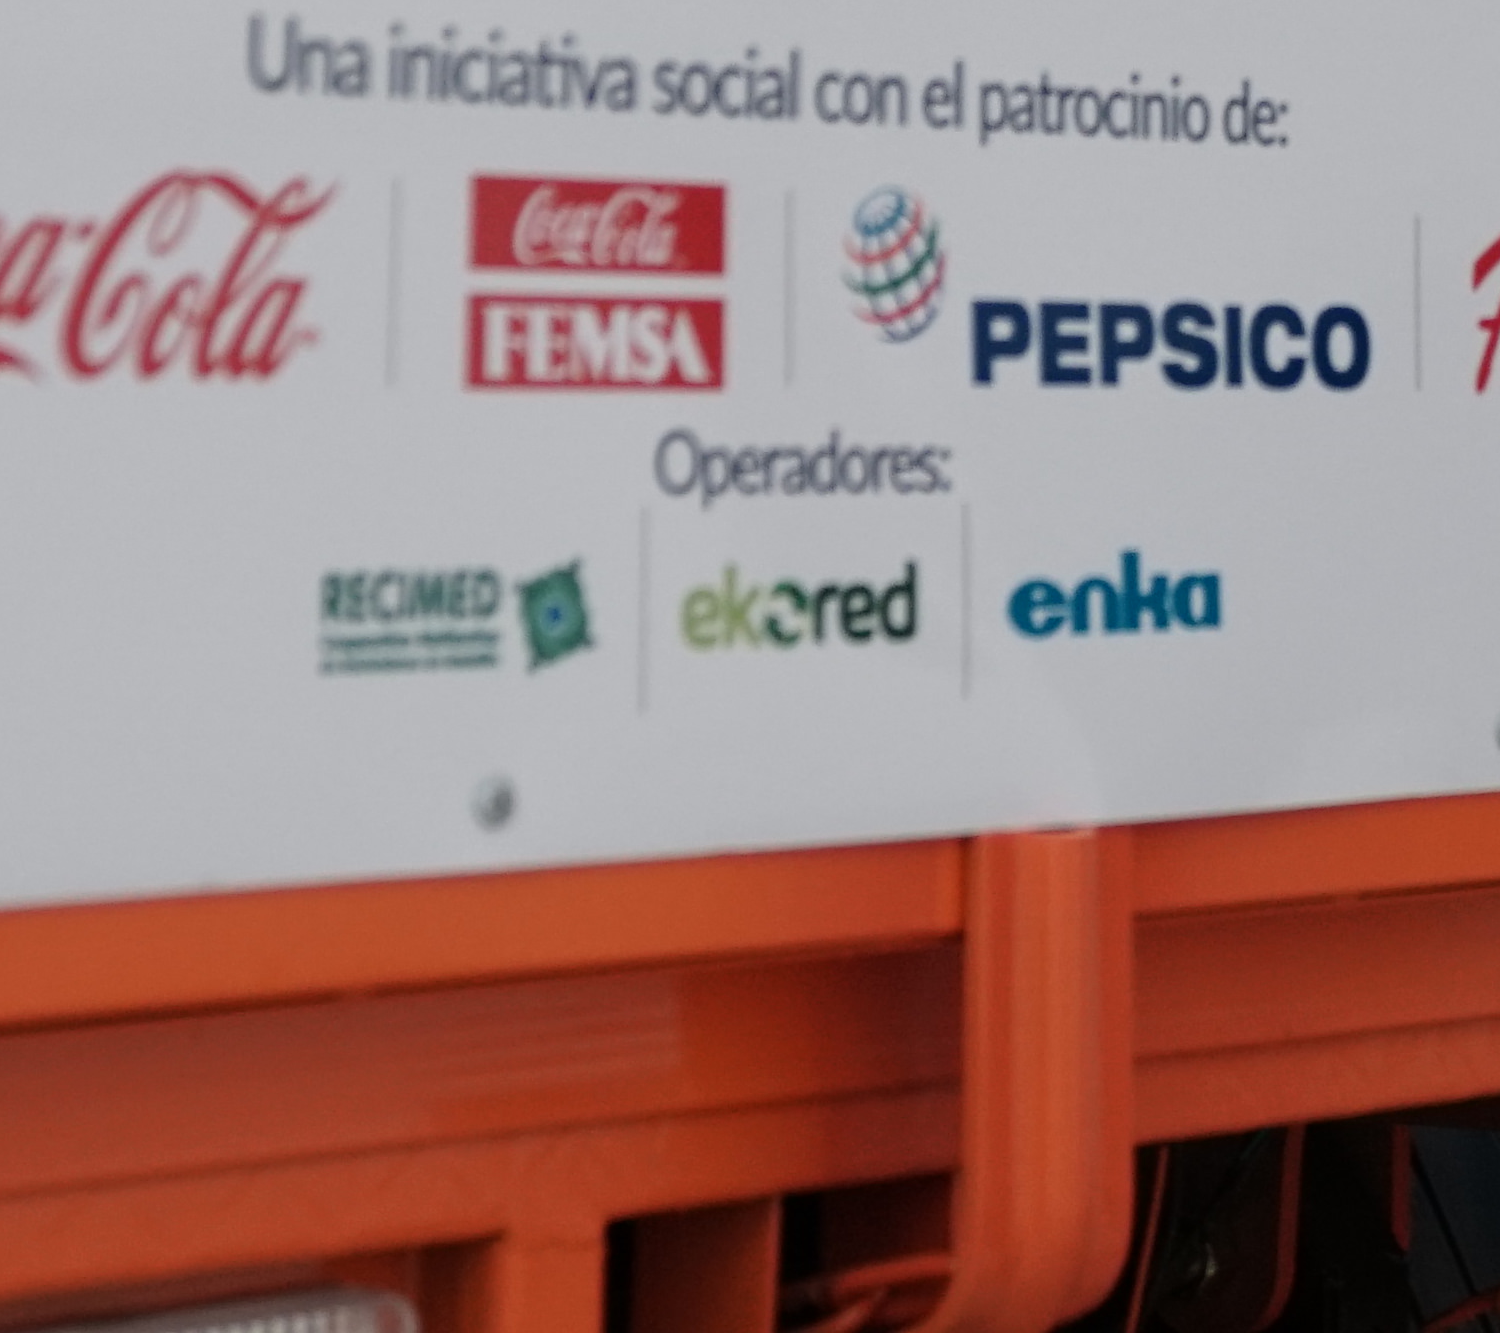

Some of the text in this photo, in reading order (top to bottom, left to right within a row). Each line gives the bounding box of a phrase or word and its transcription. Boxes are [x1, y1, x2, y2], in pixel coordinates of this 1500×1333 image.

[247, 13, 1290, 148] Una iniciativa social con el patrocinio de:
[483, 301, 713, 384] FEMSA
[970, 300, 1372, 392] PEPSICO
[653, 429, 954, 511] Operadores:
[319, 568, 502, 624] RECIMED
[1006, 546, 1222, 640] enka
